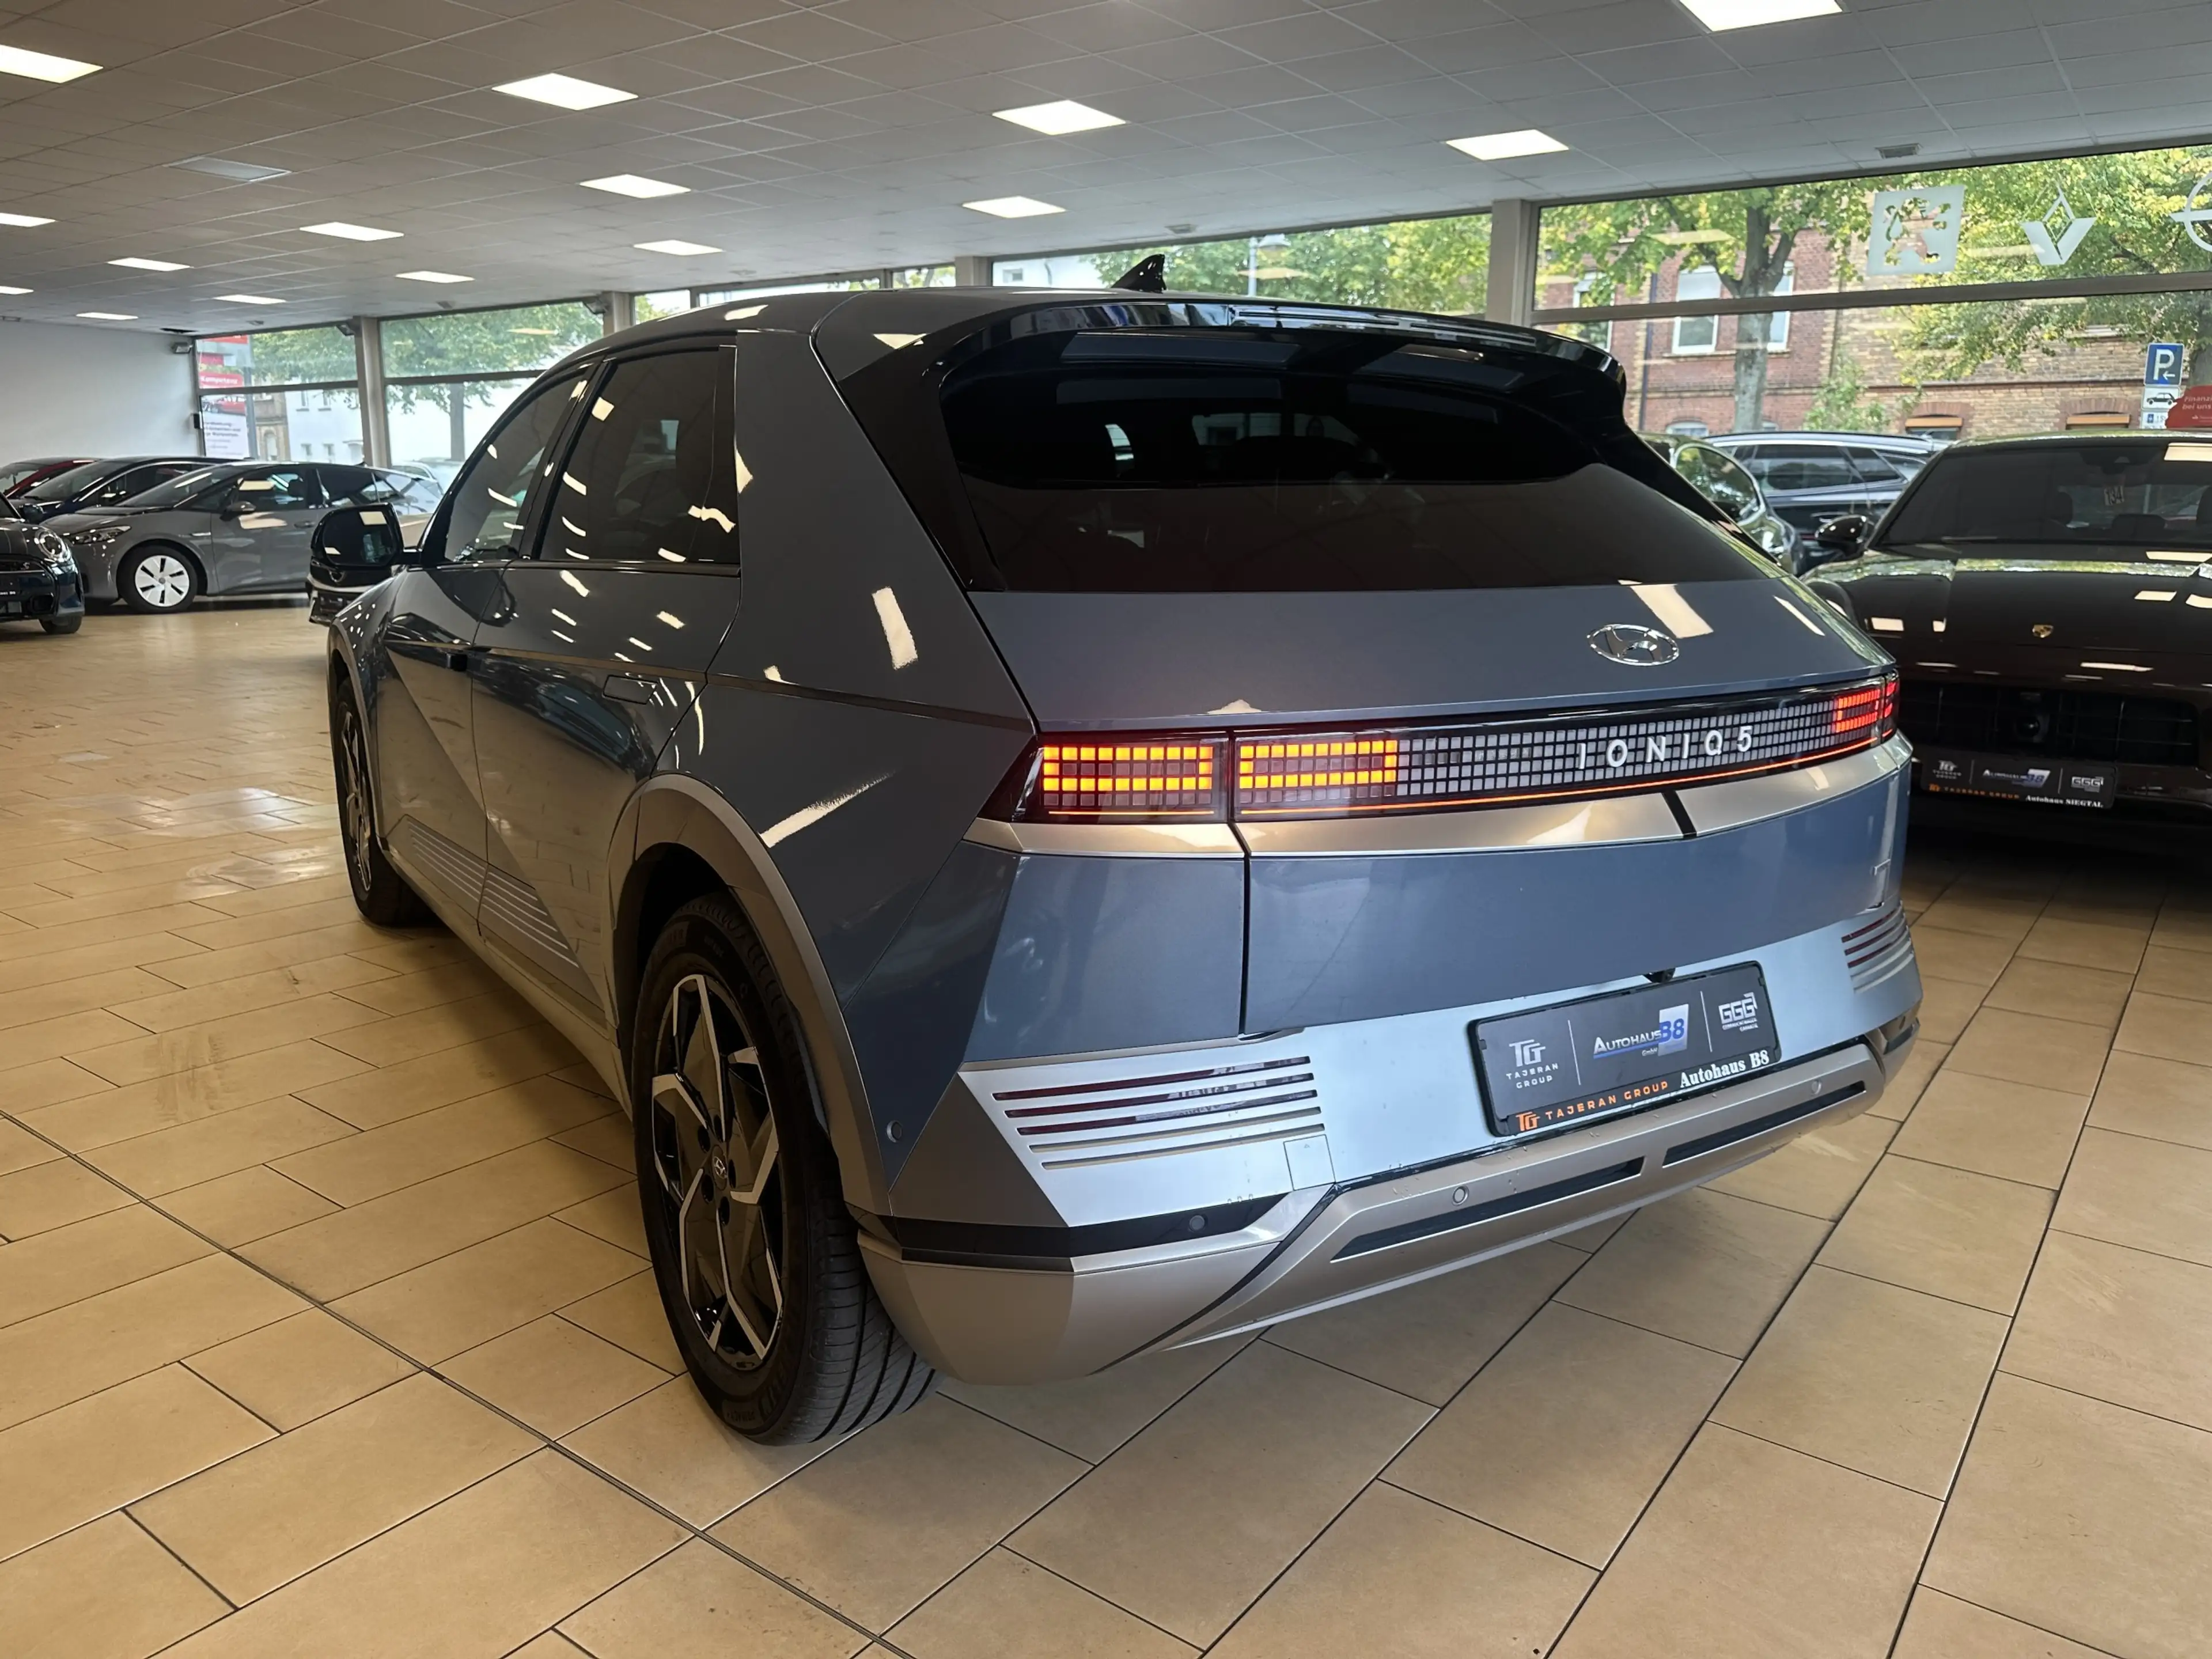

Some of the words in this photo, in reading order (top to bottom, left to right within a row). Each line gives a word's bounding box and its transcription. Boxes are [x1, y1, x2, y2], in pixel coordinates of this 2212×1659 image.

[2153, 349, 2175, 380] P
[2025, 794, 2064, 804] Autohaus
[1718, 995, 1757, 1024] GGG
[1505, 1062, 1559, 1081] TAJERAN
[1516, 1075, 1554, 1089] GROUP
[1545, 1094, 1617, 1120] TAJERAN
[1623, 1081, 1669, 1100] GROUP
[1680, 1059, 1747, 1088] Autohaus
[1748, 1049, 1770, 1069] B8
